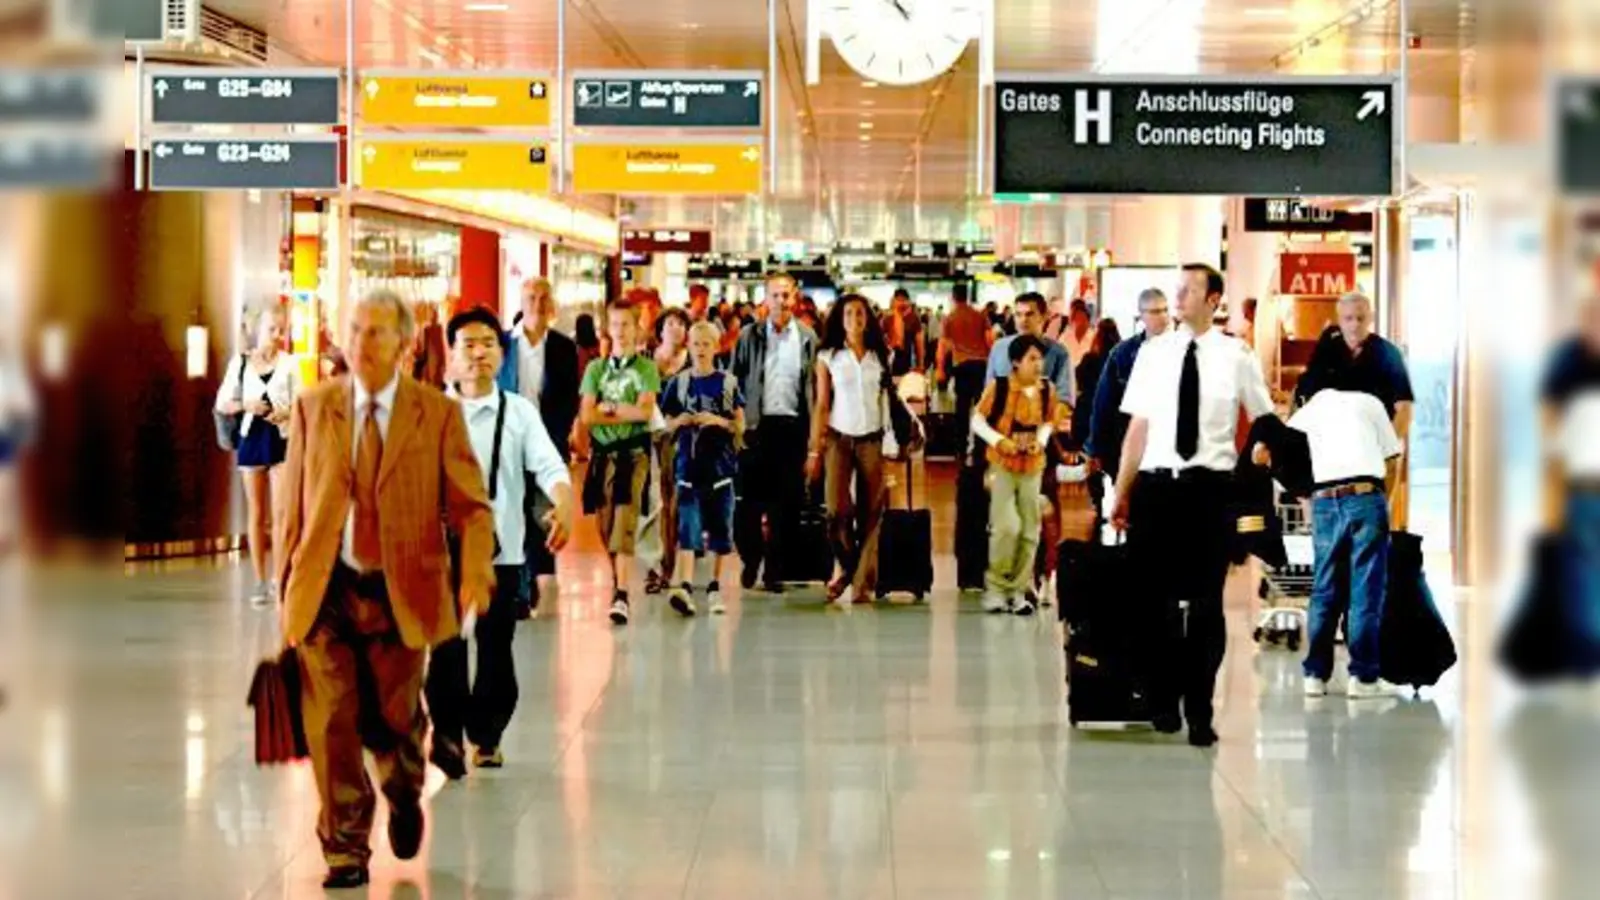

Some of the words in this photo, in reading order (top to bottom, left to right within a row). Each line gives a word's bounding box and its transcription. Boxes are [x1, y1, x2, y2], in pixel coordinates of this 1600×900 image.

[1001, 88, 1062, 111] Gates
[1074, 89, 1112, 144] H
[1136, 88, 1294, 117] Anschlussflüge
[1136, 122, 1253, 150] Connecting
[1257, 122, 1326, 150] Flights
[1289, 272, 1347, 294] ATM
